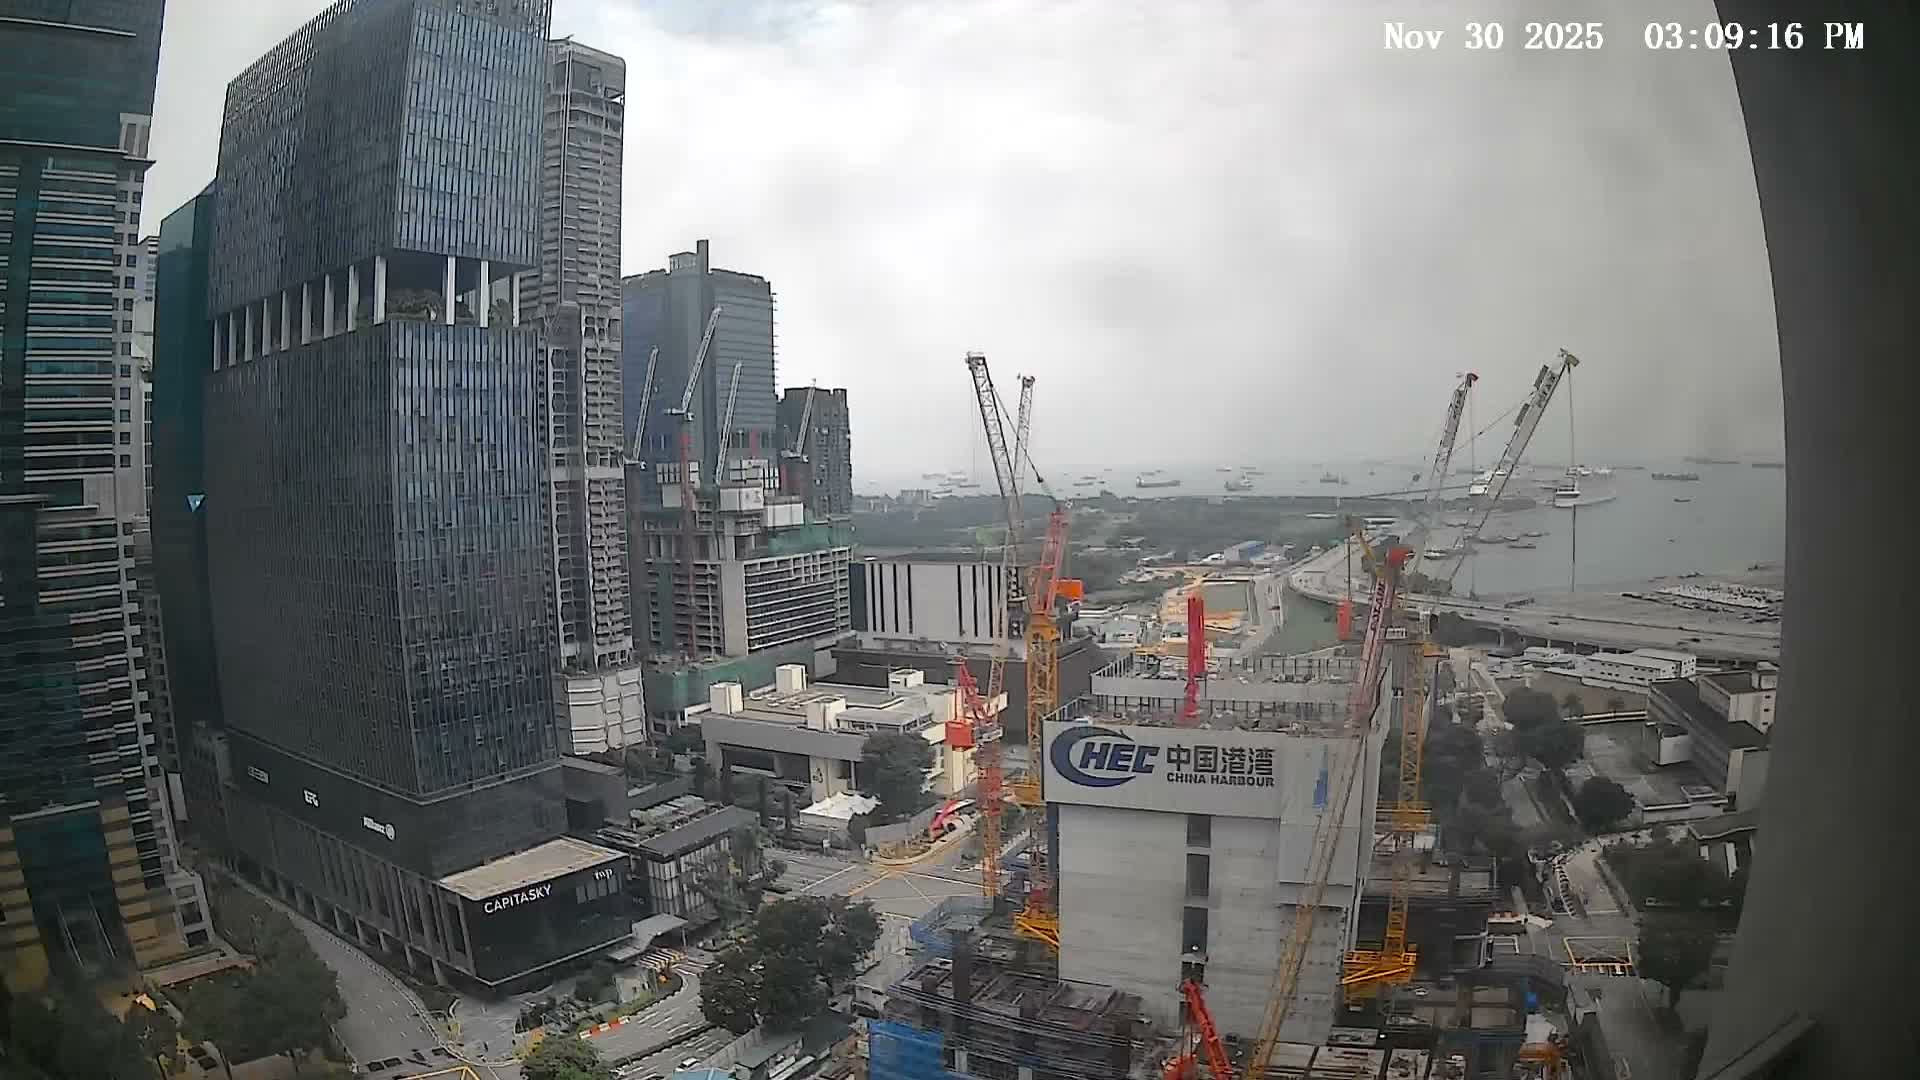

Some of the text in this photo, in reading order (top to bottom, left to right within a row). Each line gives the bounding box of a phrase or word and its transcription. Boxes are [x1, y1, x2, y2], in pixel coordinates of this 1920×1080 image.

[1166, 744, 1275, 776] 中国港湾
[1166, 772, 1275, 788] CHINA HARBOUR
[484, 883, 553, 914] CAPITASKY
